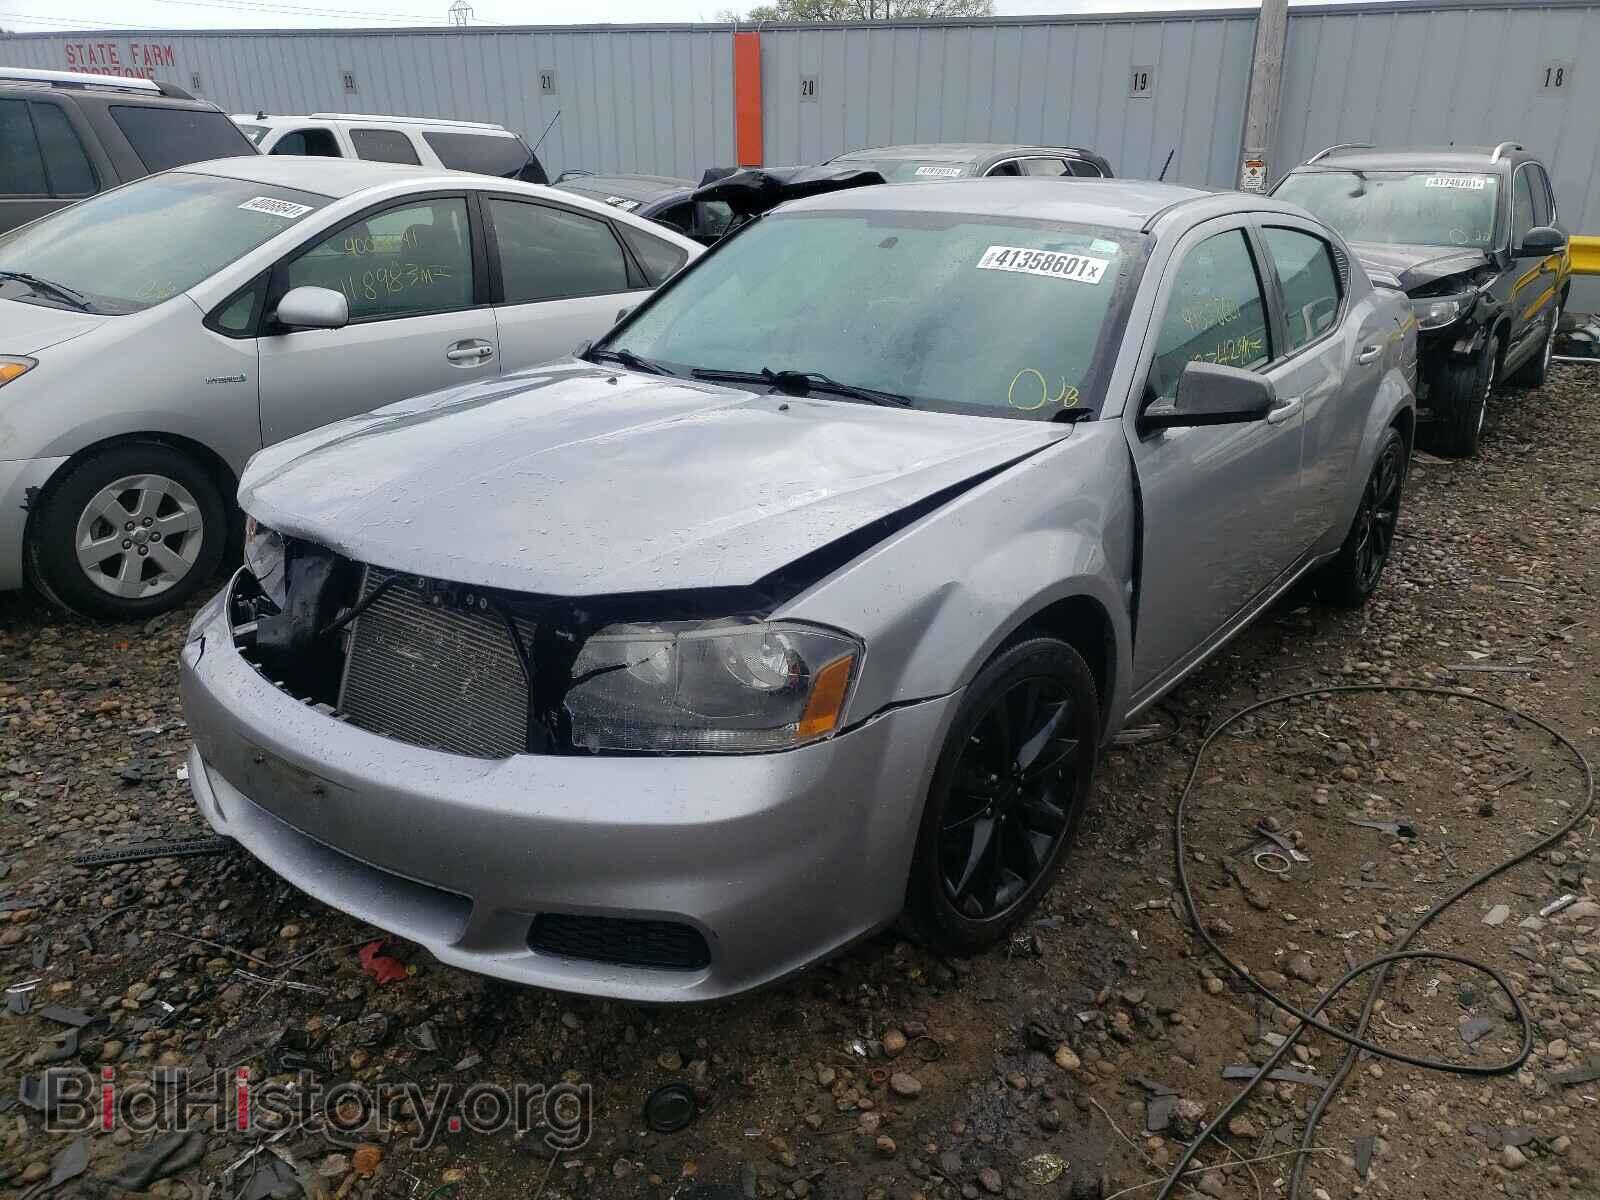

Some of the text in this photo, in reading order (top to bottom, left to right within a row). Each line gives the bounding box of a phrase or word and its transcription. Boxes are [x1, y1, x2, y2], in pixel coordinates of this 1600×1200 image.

[65, 43, 175, 67] STATE FARM
[541, 75, 551, 89] 21
[1134, 71, 1147, 90] 19
[1545, 67, 1564, 87] 18
[802, 80, 814, 95] 20
